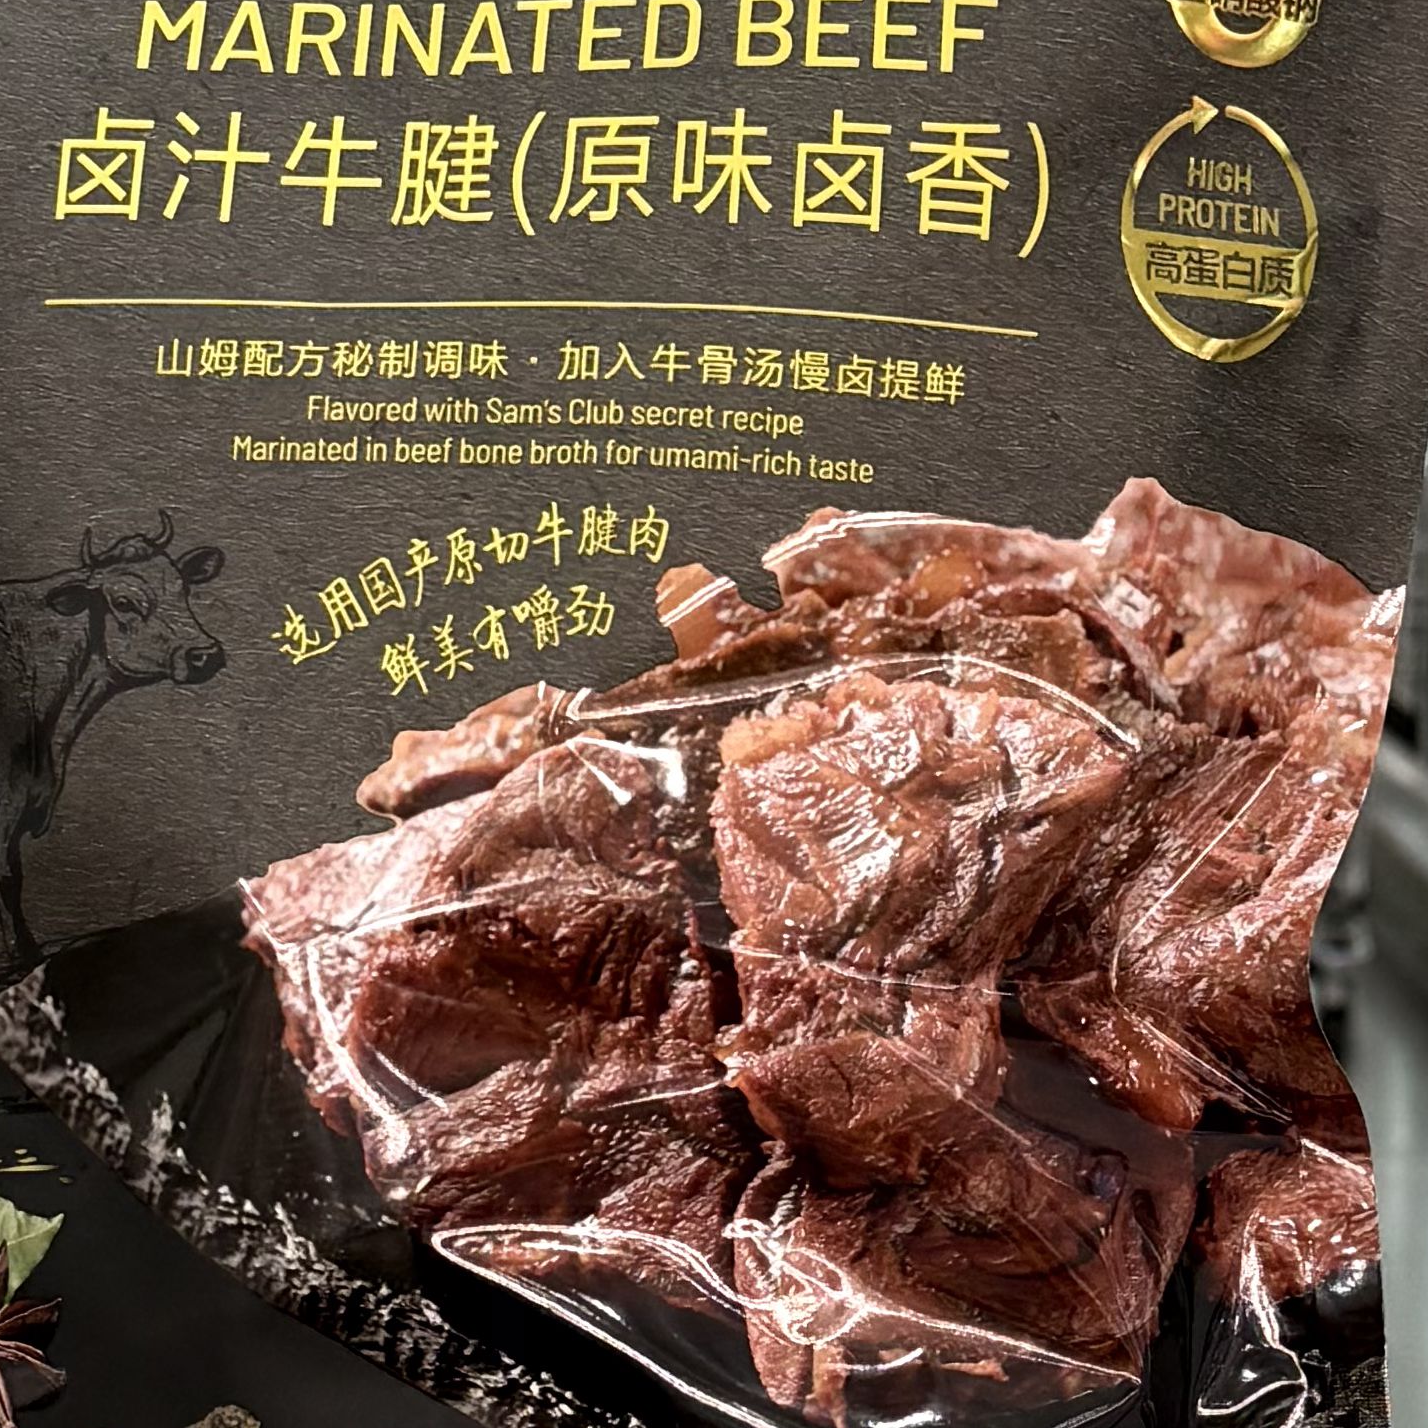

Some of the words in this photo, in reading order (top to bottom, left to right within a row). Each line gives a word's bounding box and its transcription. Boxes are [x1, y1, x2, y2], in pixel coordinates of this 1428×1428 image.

[54, 106, 1050, 259] 卤汁牛腱(原味卤香)
[1186, 156, 1253, 196] HIGH
[1158, 192, 1280, 237] PROTEIN
[1145, 241, 1296, 298] 高蛋白质
[307, 395, 417, 422] Flavored
[424, 396, 478, 423] with
[485, 397, 562, 425] Sam's
[568, 398, 624, 424] Club
[630, 404, 715, 429] secret
[722, 407, 805, 439] recipe
[231, 435, 358, 462] Marinated
[366, 436, 388, 463] in
[394, 437, 454, 464] beef
[459, 438, 523, 465] bone
[529, 439, 598, 465] broth
[605, 439, 643, 466] for
[649, 444, 802, 477] umami-rich
[808, 454, 874, 484] taste
[271, 501, 670, 665] 选用国产原切牛腱肉
[380, 583, 616, 697] 鲜美有嚼劲
